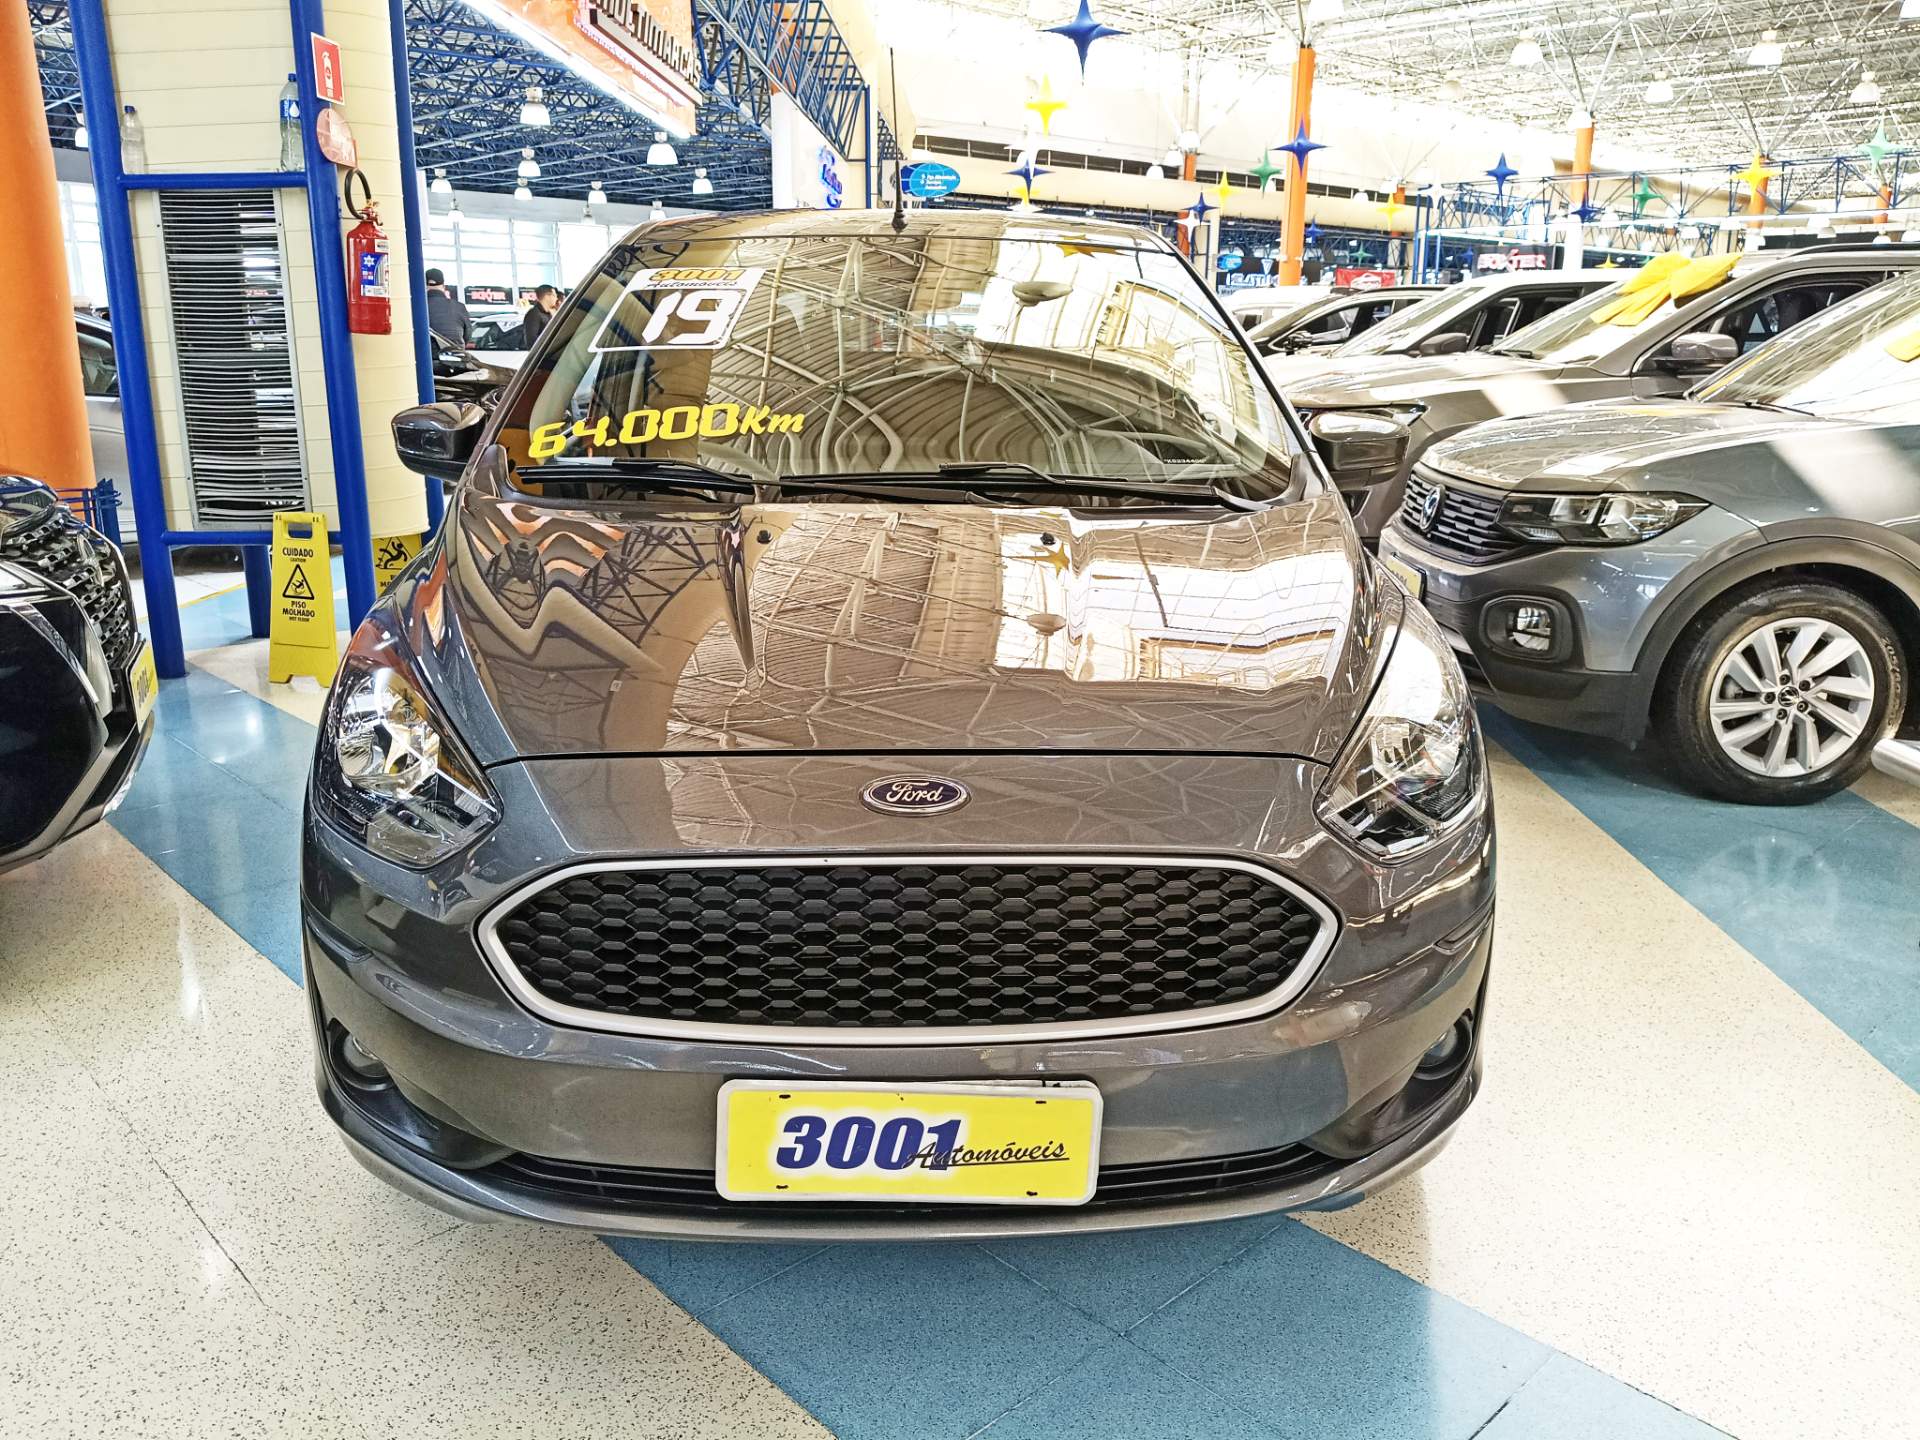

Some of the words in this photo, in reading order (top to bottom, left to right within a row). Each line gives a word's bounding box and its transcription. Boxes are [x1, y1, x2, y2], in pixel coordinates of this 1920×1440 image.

[648, 267, 747, 282] 3001
[641, 289, 743, 345] 19
[282, 546, 314, 558] CUIDADO
[290, 600, 307, 609] PISO
[282, 607, 316, 618] MOLHADO
[886, 781, 944, 802] Ford
[775, 1115, 962, 1171] 3001
[906, 1140, 1068, 1169] Automóveis
